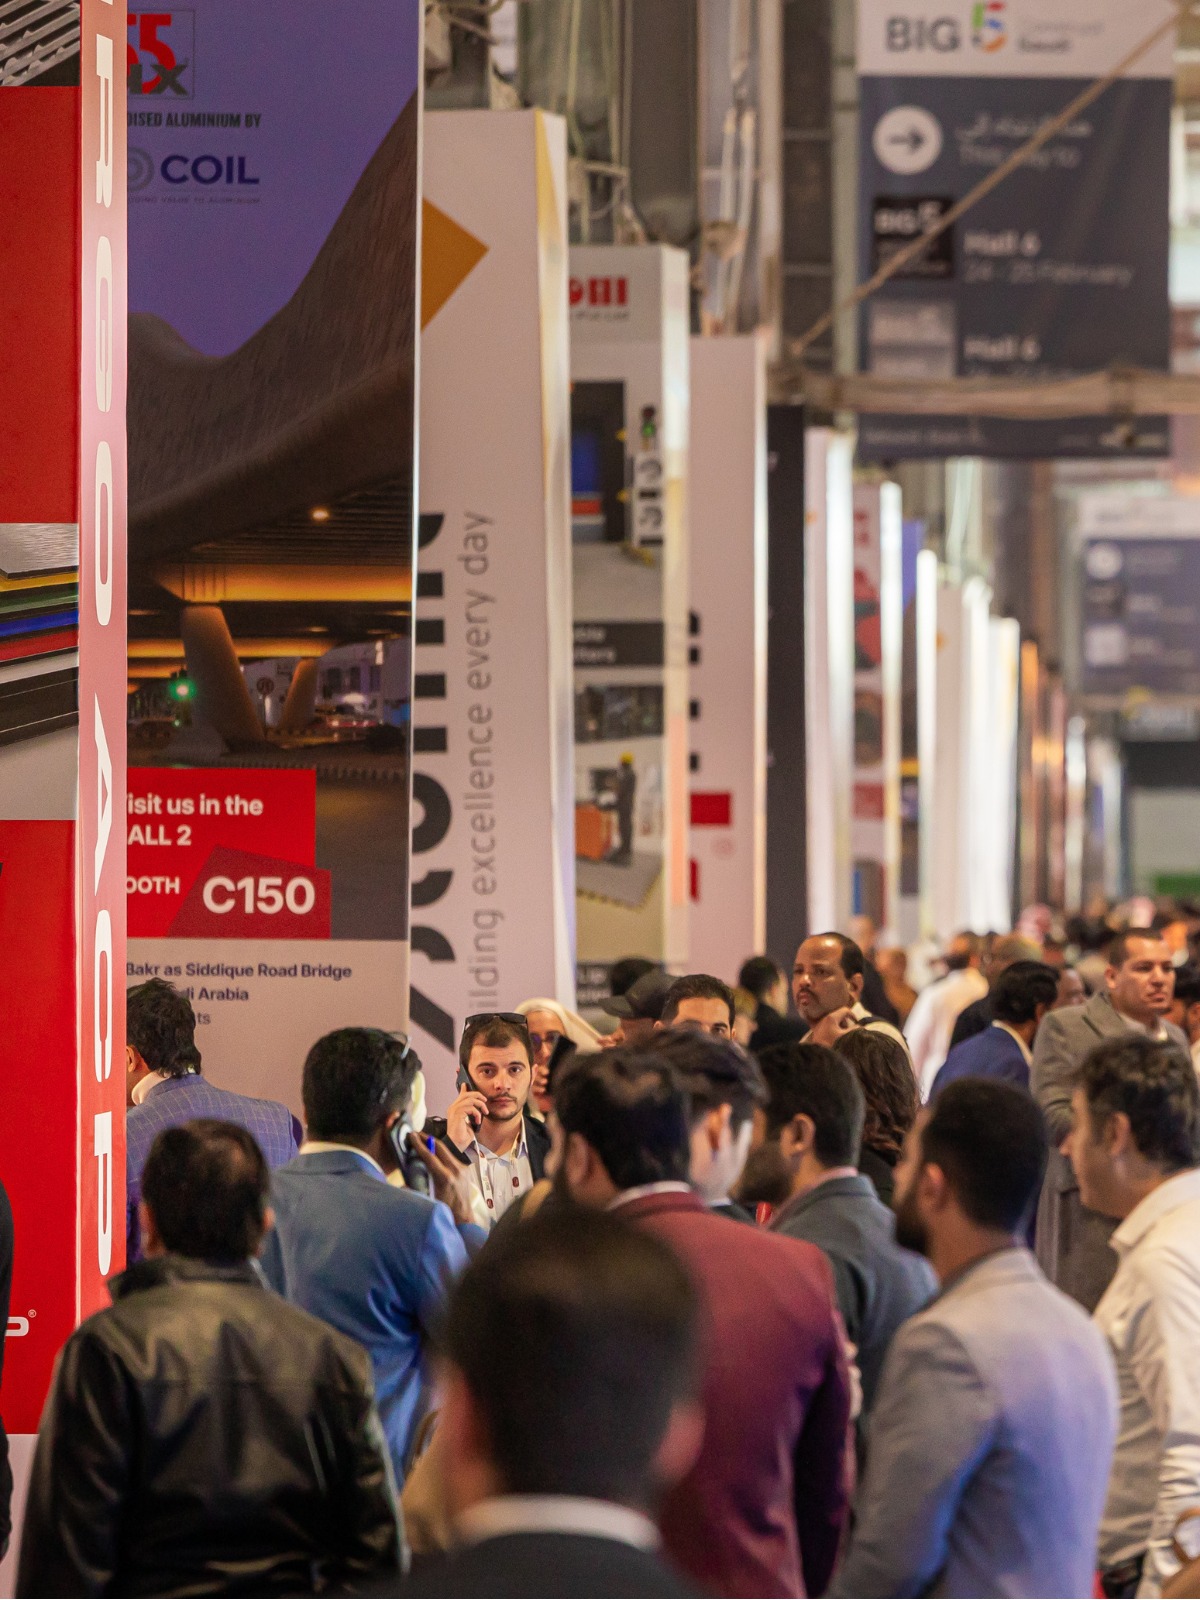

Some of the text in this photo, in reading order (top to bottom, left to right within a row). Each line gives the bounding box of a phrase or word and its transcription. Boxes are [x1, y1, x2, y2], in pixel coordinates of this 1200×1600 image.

[886, 17, 960, 52] BIG
[166, 113, 241, 127] ALUMINIUM
[245, 114, 261, 128] BY
[161, 154, 260, 185] COIL
[94, 0, 114, 626] RGO
[457, 510, 495, 577] day
[464, 588, 497, 691] every
[167, 797, 194, 815] us
[199, 794, 220, 815] in
[225, 794, 263, 815] the
[463, 702, 498, 896] excellence
[177, 825, 192, 846] 2
[203, 876, 315, 915] C150
[164, 966, 182, 977] as
[185, 962, 254, 980] Siddique
[258, 963, 297, 977] Road
[301, 963, 352, 981] Bridge
[198, 986, 249, 1001] Arabia
